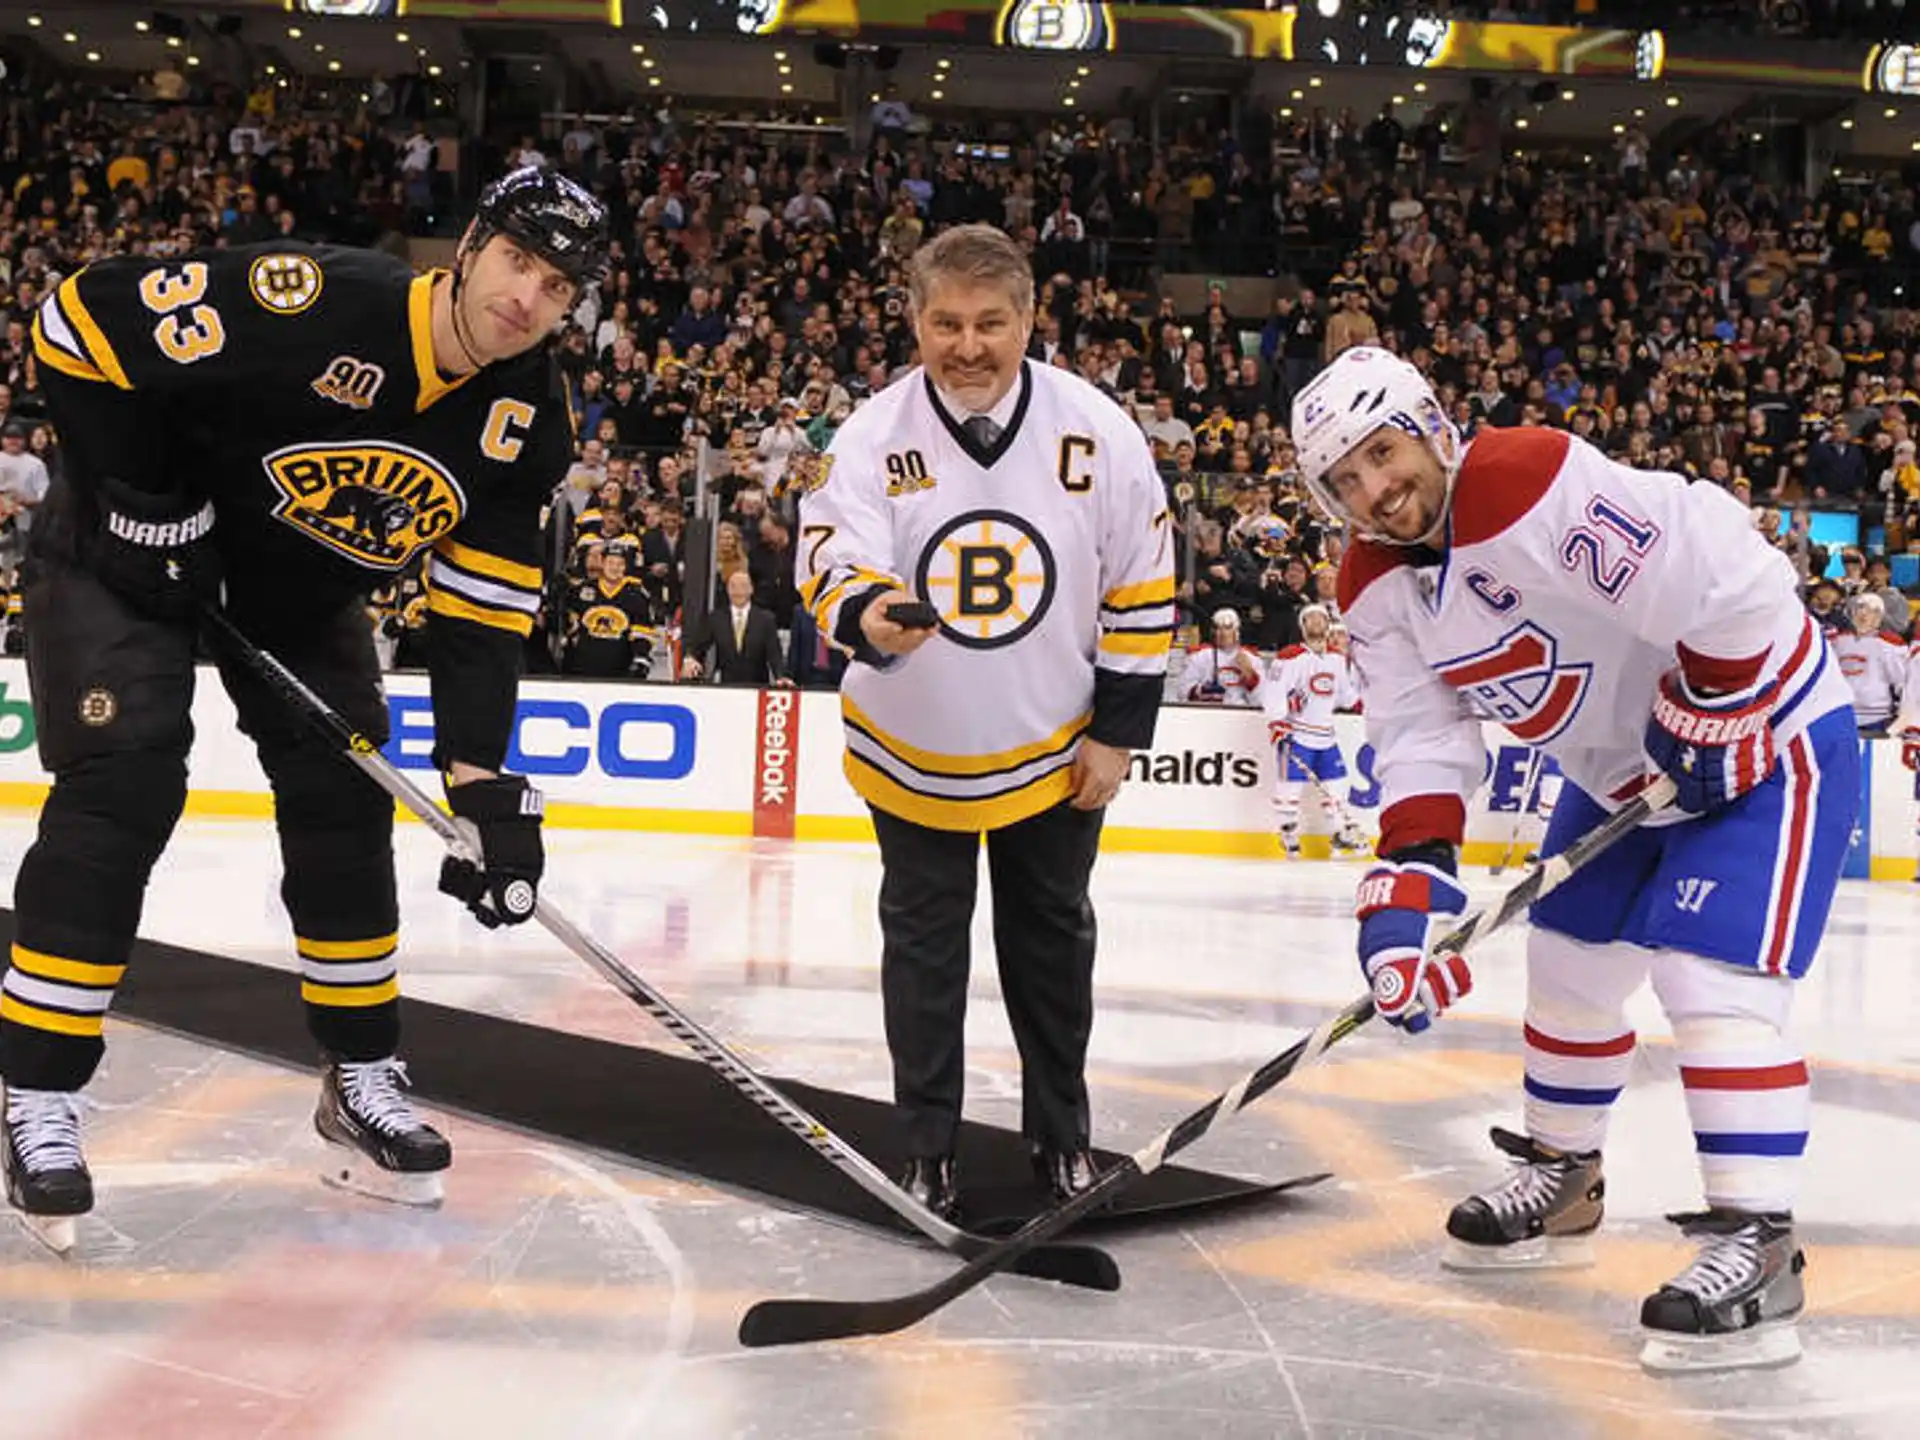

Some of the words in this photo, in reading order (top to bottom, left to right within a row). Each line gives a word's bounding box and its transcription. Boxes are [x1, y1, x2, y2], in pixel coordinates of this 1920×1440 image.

[1035, 4, 1063, 41] B
[269, 269, 303, 291] B
[139, 262, 226, 364] 33
[326, 358, 384, 400] 90
[481, 397, 536, 462] C
[886, 450, 928, 486] 90
[1059, 434, 1095, 492] C
[281, 456, 453, 538] BRUINS
[803, 525, 836, 576] 7
[1559, 493, 1662, 604] 21
[956, 546, 1016, 616] B
[1465, 567, 1521, 617] C
[761, 690, 793, 805] Reebok
[1124, 750, 1259, 788] nald's
